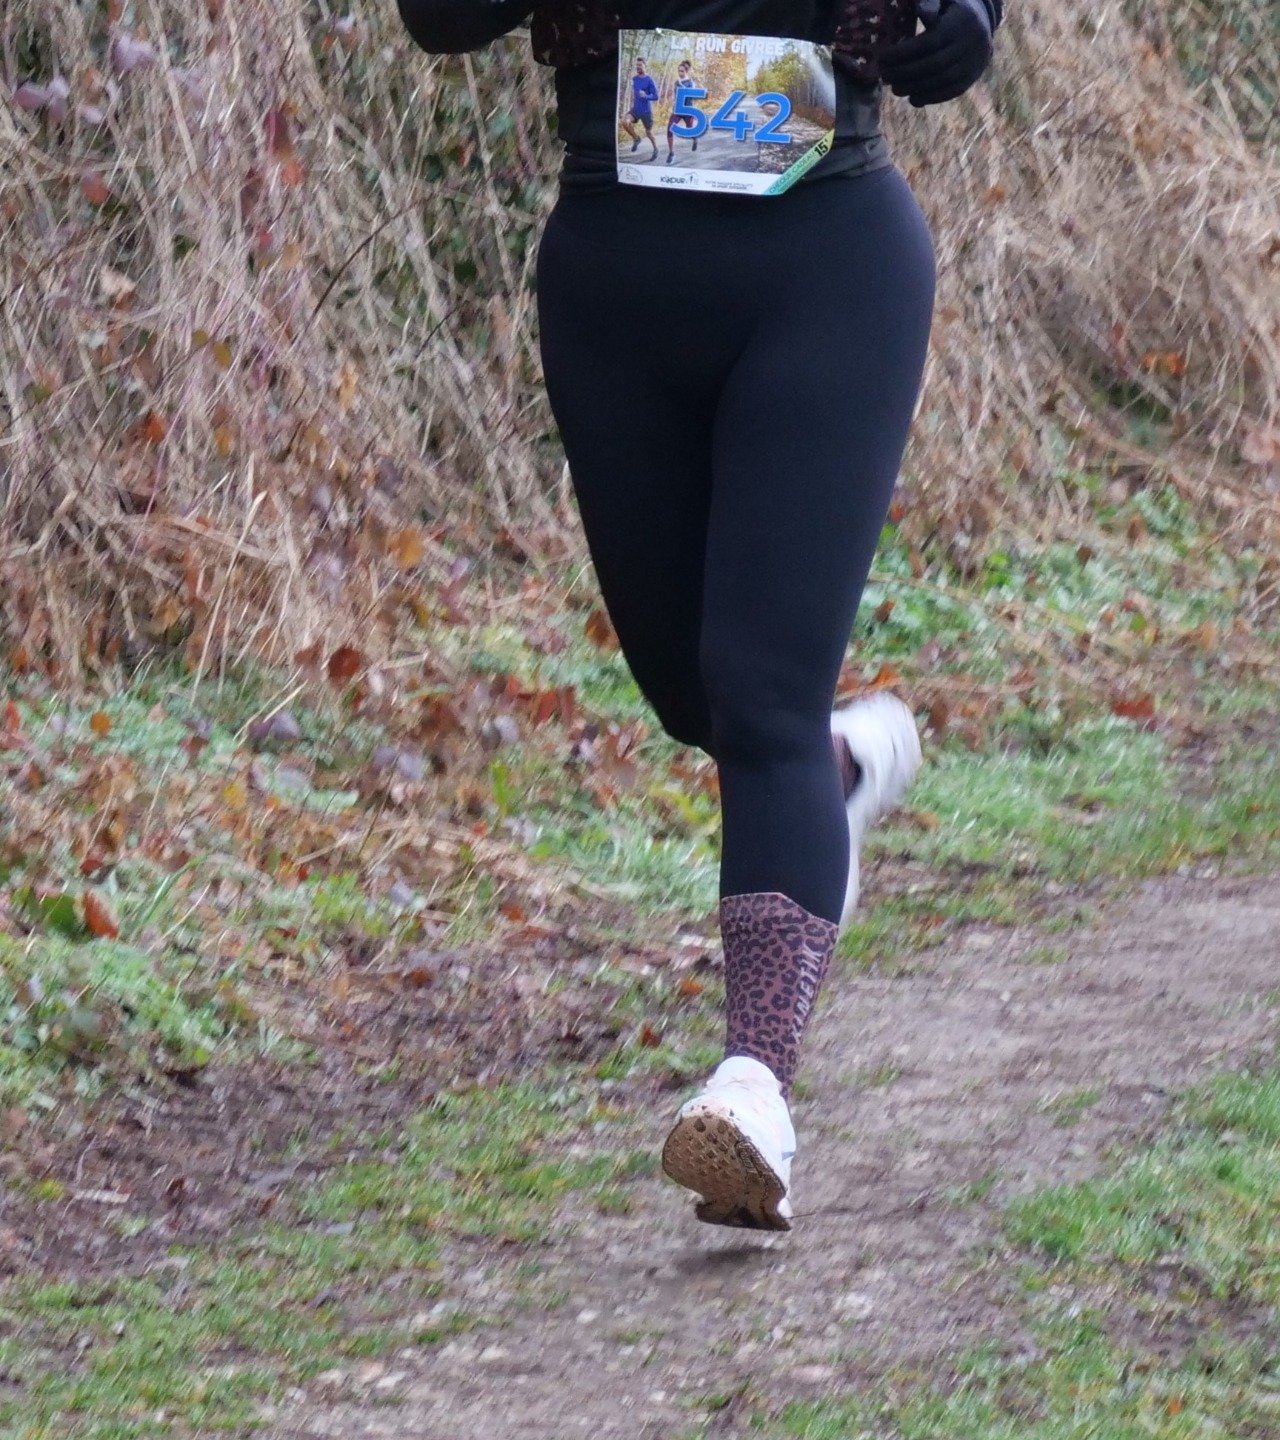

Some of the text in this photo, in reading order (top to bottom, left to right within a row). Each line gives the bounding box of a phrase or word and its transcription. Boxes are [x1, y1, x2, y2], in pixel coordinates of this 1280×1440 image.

[670, 34, 690, 50] LA
[670, 86, 793, 144] 542
[789, 939, 824, 1045] KINETIK
